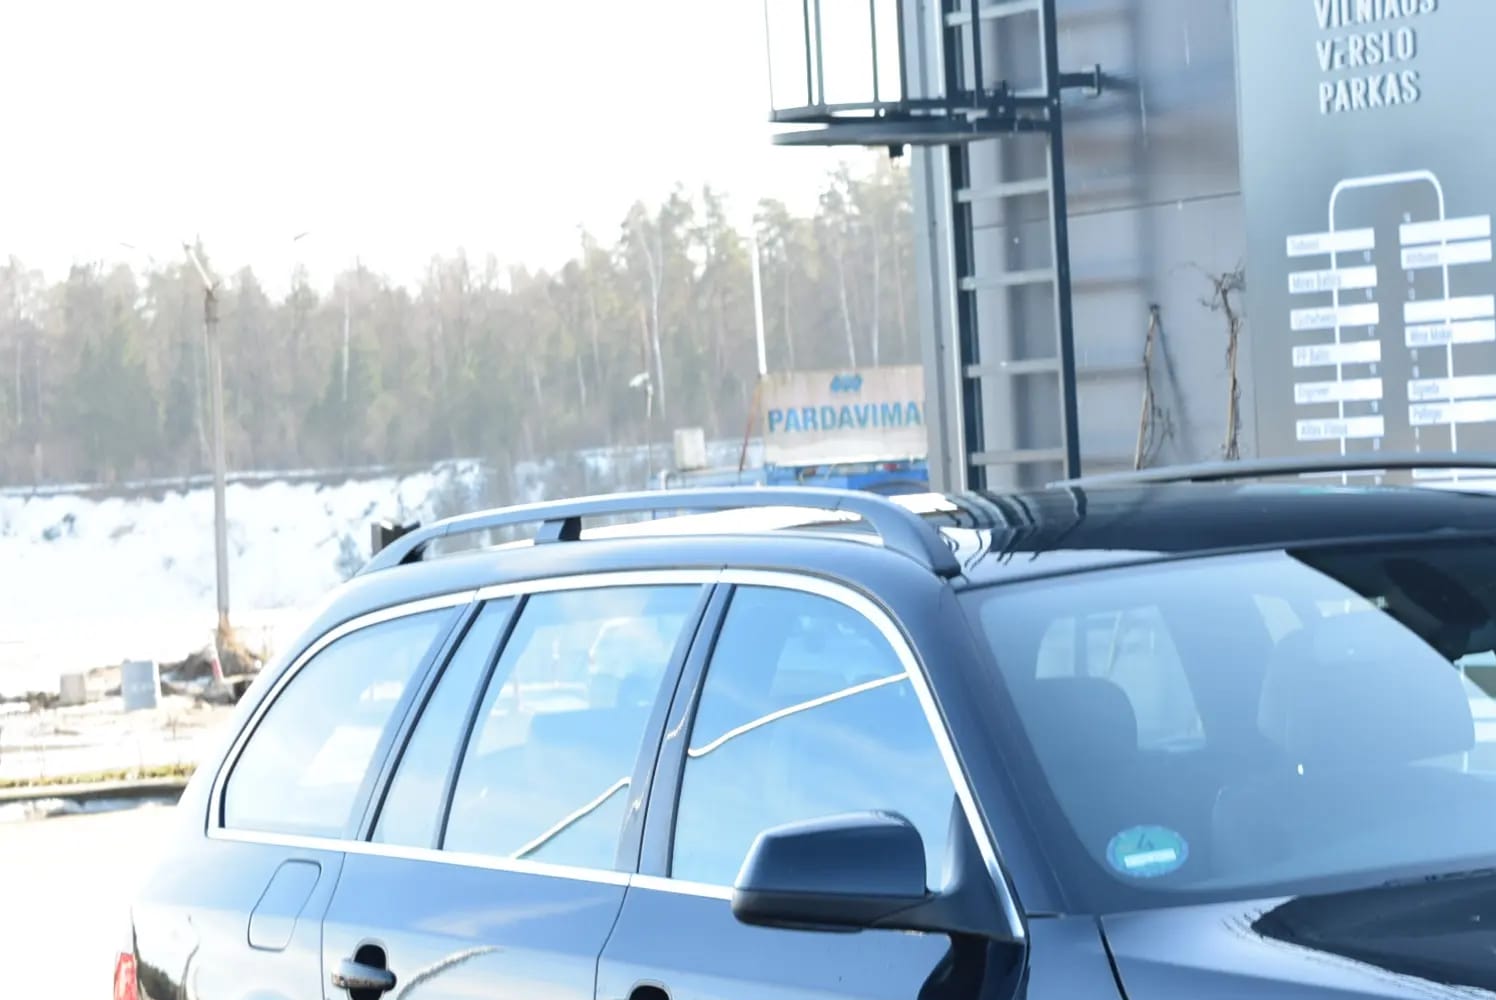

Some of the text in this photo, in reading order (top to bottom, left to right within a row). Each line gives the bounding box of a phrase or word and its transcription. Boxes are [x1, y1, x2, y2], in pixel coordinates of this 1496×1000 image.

[1316, 27, 1417, 72] VERSLO
[1320, 70, 1421, 115] PARKAS
[768, 401, 926, 432] PARDAVIMA
